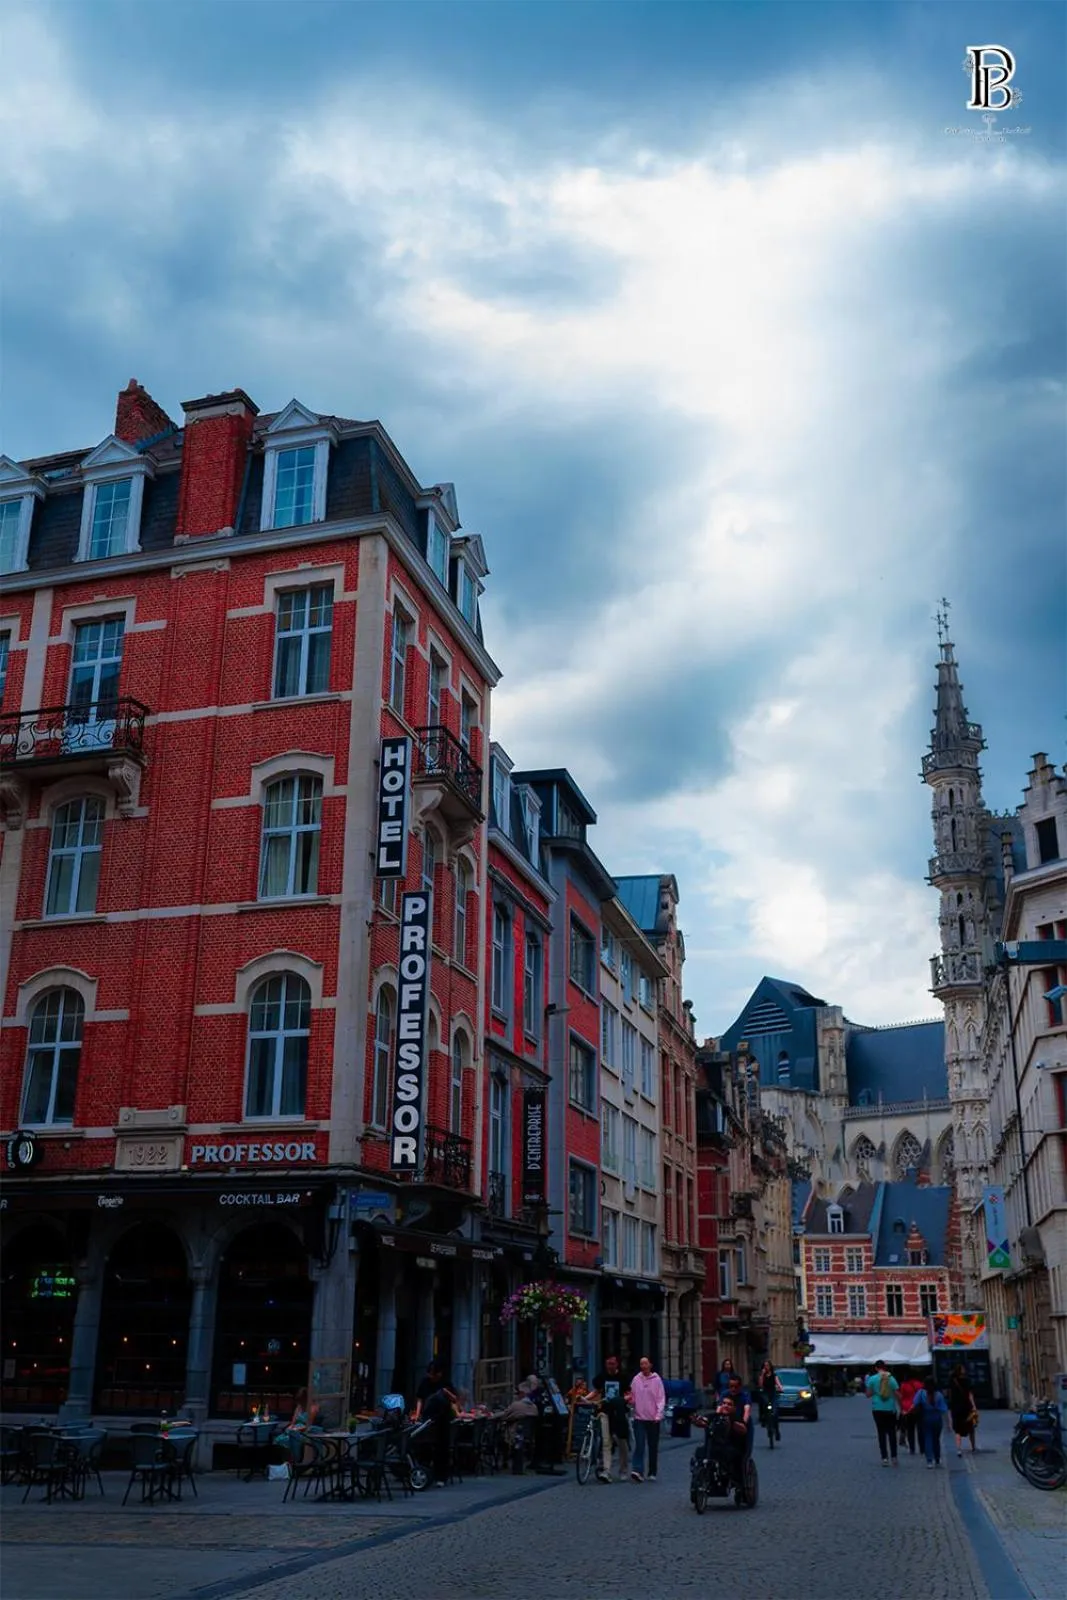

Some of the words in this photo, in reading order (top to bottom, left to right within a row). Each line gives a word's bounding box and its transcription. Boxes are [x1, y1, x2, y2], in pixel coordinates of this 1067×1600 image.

[380, 744, 405, 868] HOTEL
[393, 896, 426, 1164] PROFESSOR
[129, 1144, 168, 1166] 1922
[191, 1142, 317, 1163] PROFESSOR
[527, 1104, 542, 1170] D'ENTREPRISE
[219, 1193, 275, 1205] COCKTAIL
[277, 1193, 301, 1204] BAR
